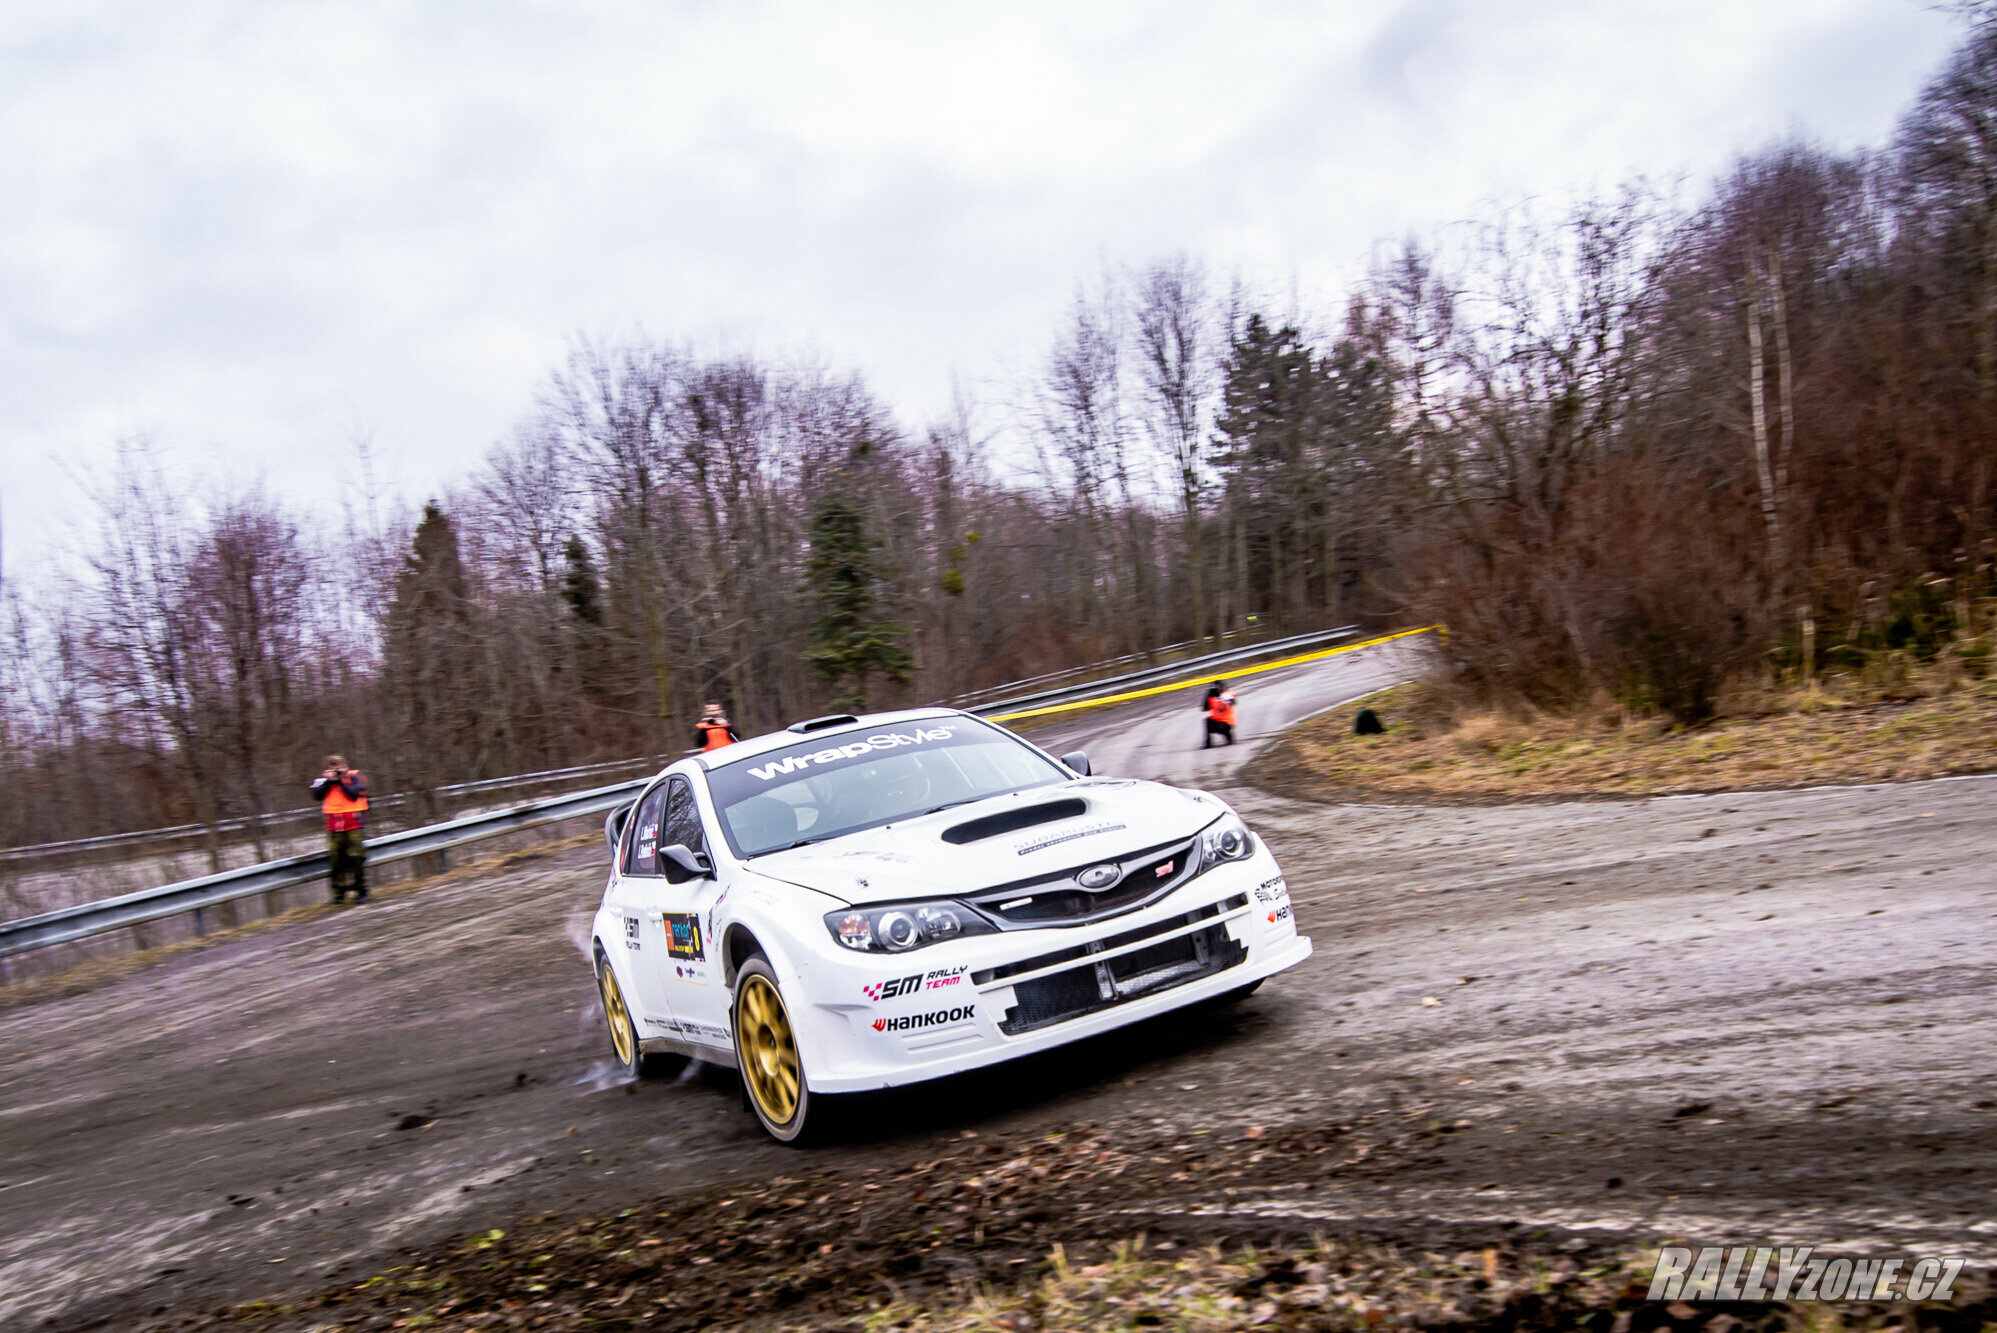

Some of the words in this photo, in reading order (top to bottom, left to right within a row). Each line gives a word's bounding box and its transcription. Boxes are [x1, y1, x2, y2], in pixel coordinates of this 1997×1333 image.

[693, 926, 700, 952] 8
[881, 973, 924, 1000] SM
[927, 965, 968, 981] RALLY
[926, 976, 961, 990] TEAM
